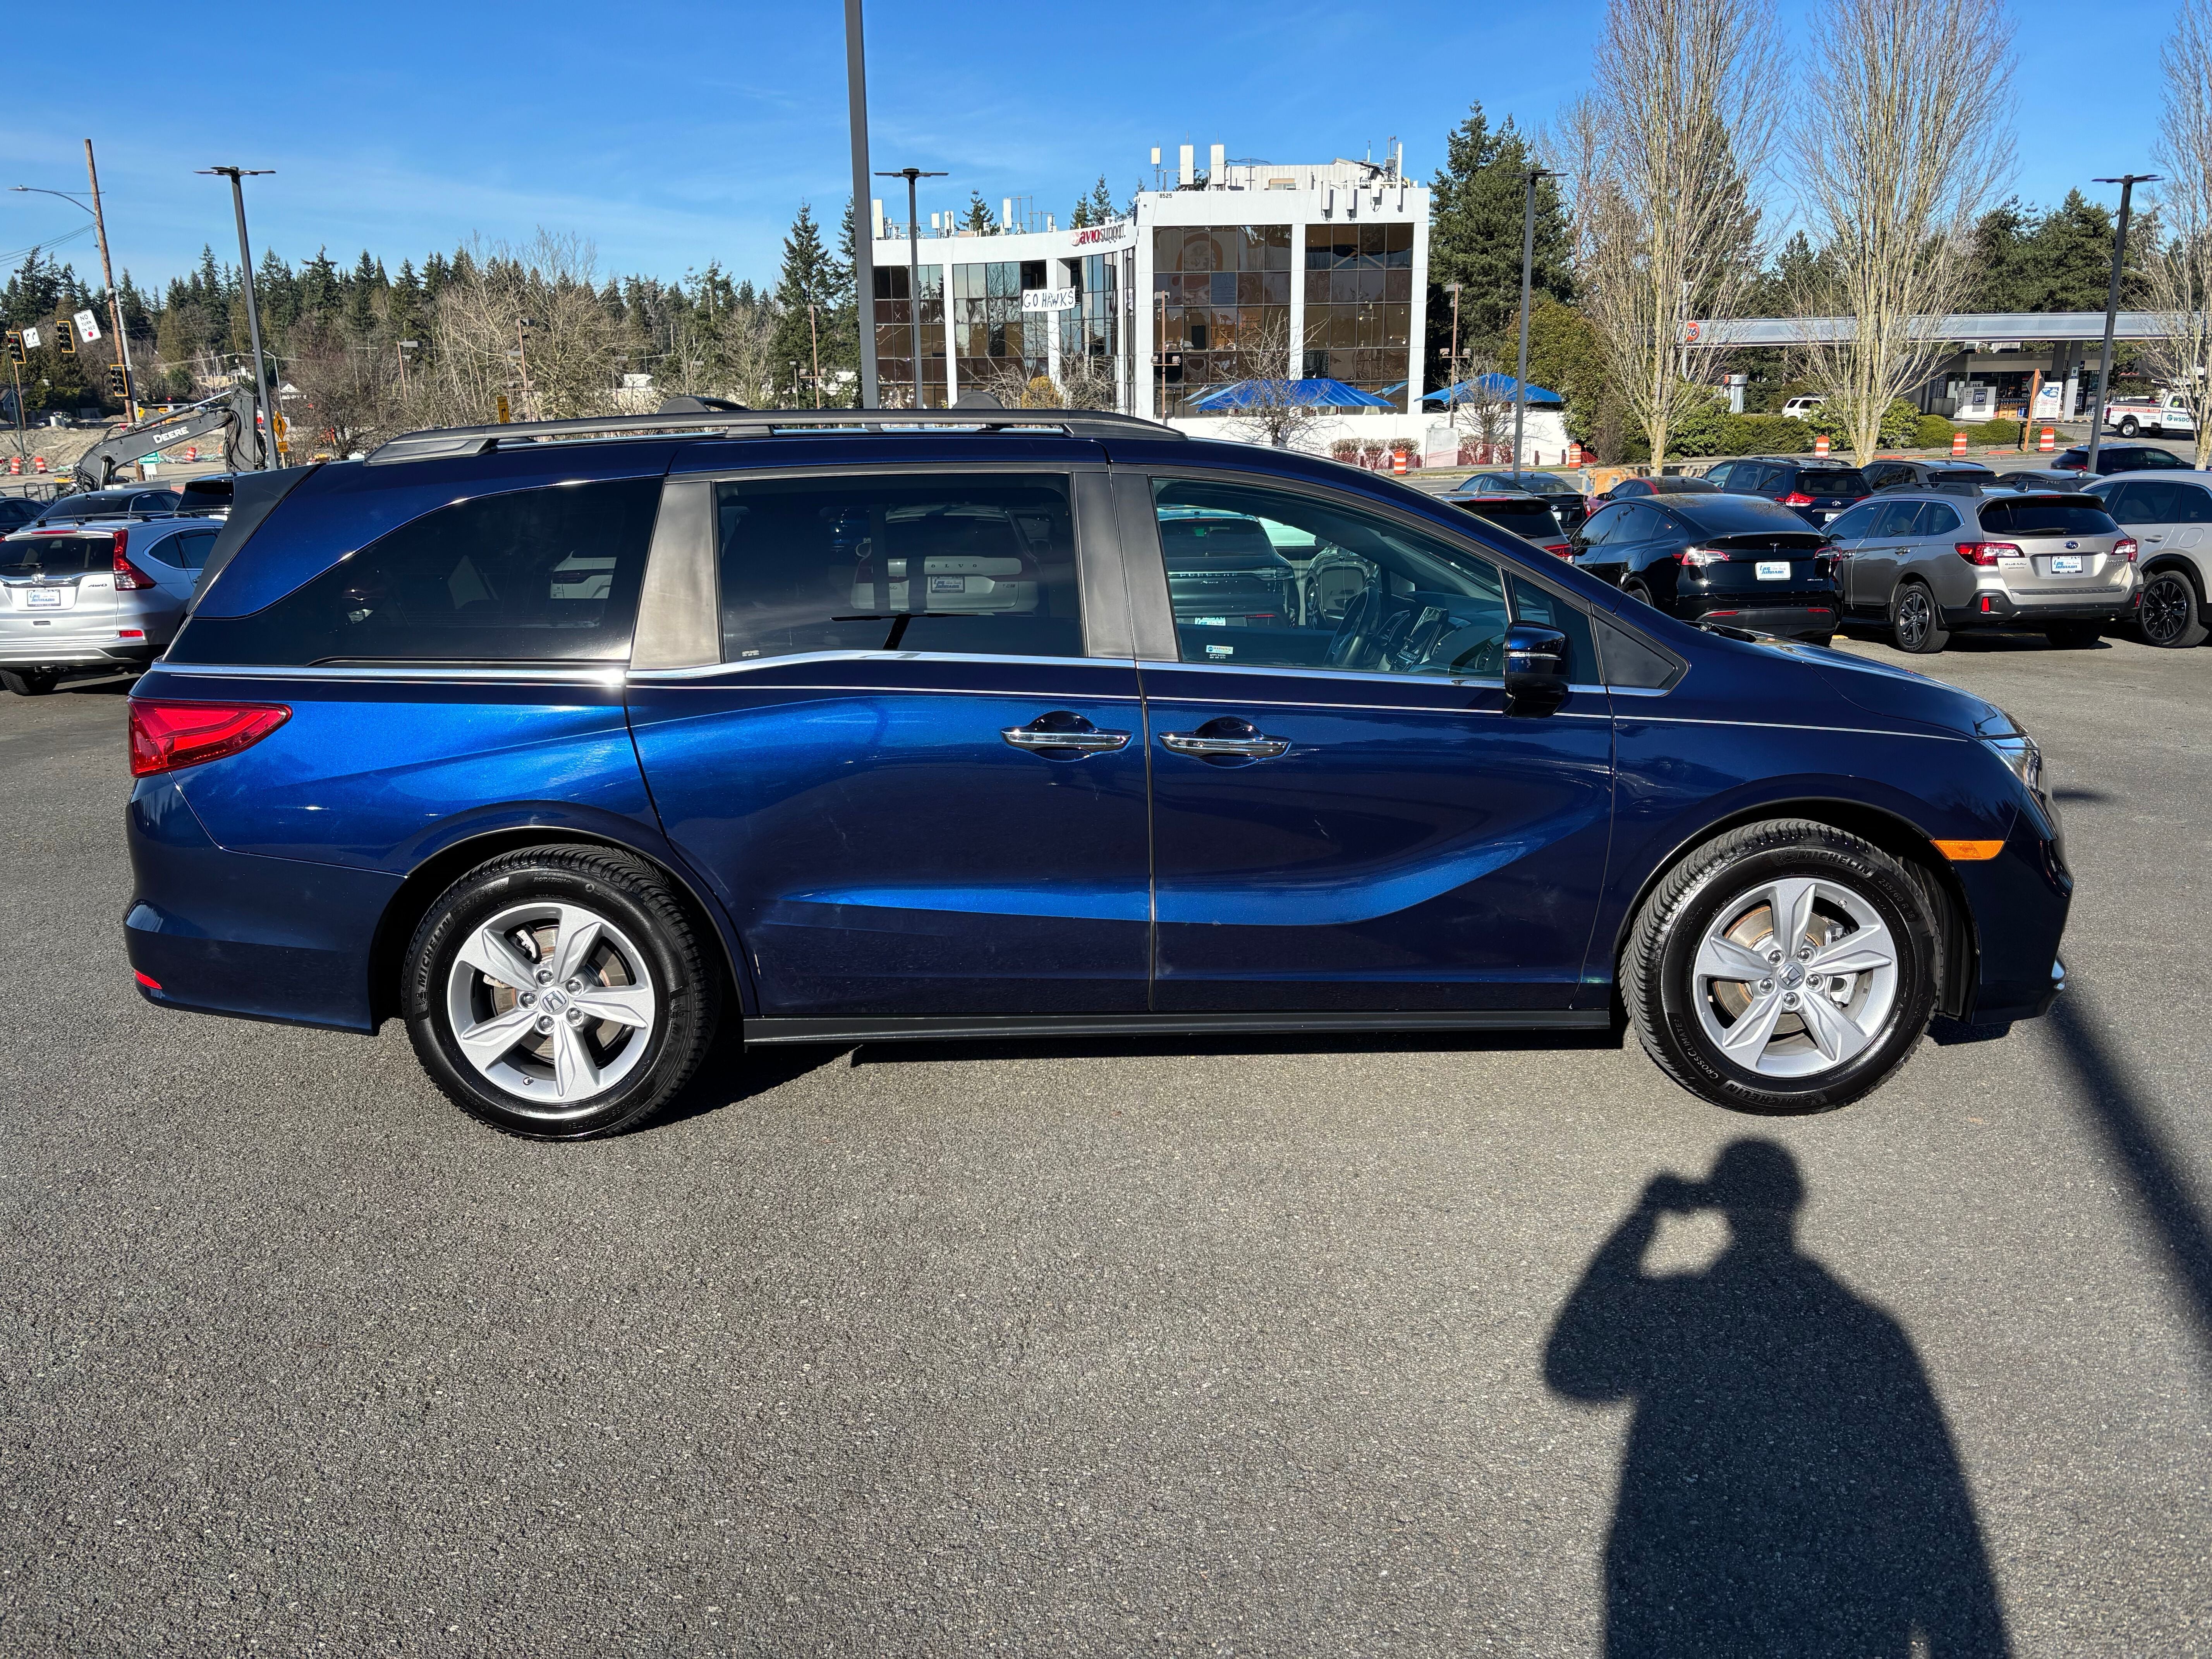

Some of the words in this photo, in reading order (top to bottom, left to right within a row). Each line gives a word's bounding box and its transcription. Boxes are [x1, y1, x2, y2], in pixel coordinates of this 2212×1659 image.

[1079, 222, 1127, 245] aviosupport
[1024, 294, 1038, 308] GO
[1042, 290, 1073, 309] HAWKS
[1688, 328, 1697, 337] 76
[153, 426, 189, 444] DEERE
[1798, 851, 1872, 875] MICHELIN
[495, 883, 504, 891] 18
[1878, 878, 1904, 902] 235/60
[417, 913, 453, 988] MICHELIN
[1724, 1083, 1801, 1103] MICHELIN
